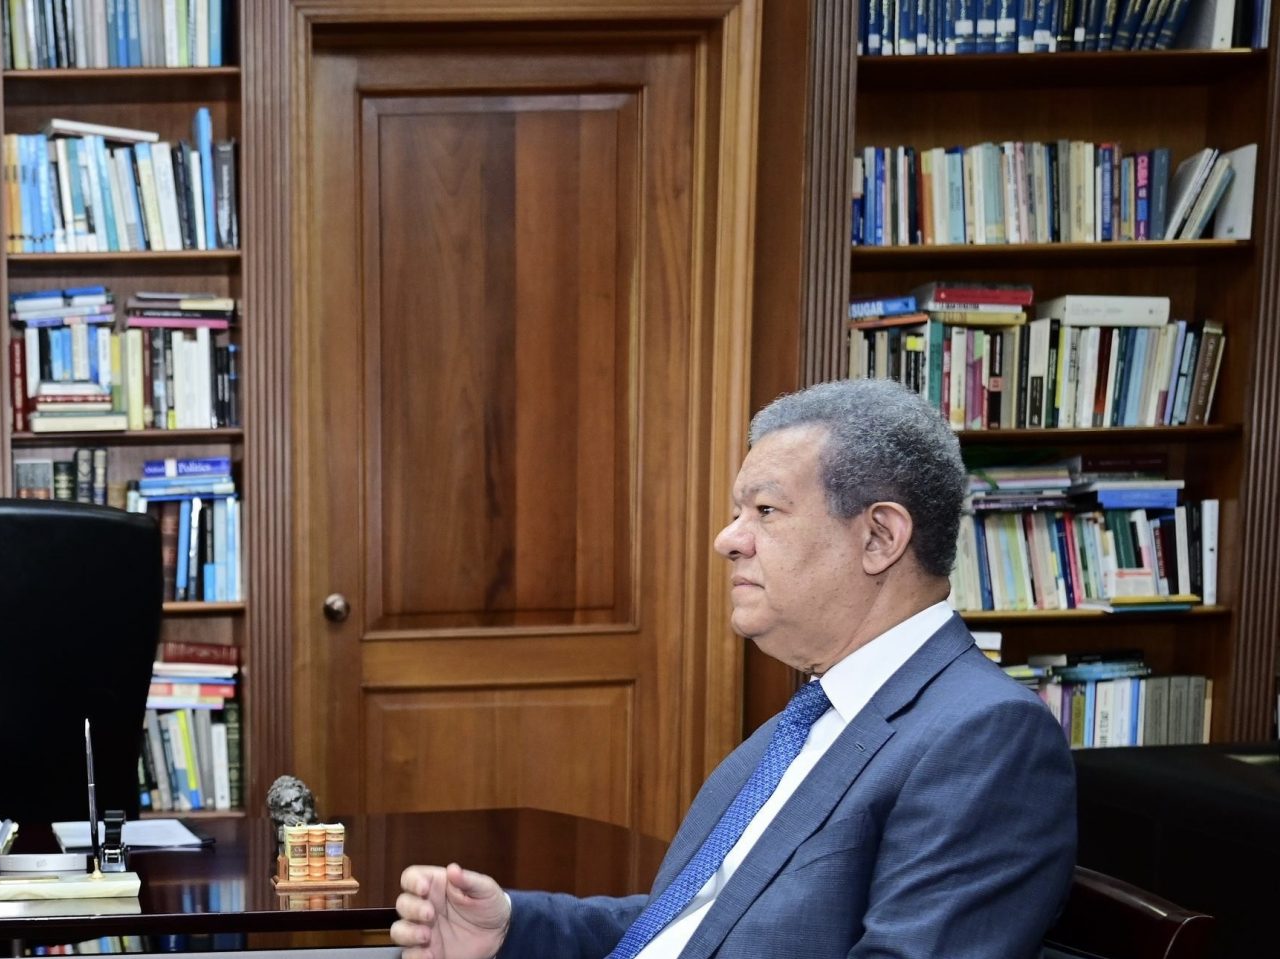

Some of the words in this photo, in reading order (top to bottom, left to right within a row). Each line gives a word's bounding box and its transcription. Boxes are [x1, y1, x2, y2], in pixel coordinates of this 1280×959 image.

[1137, 156, 1148, 187] CUBA
[852, 301, 884, 316] SUGAR
[178, 461, 211, 473] Politics
